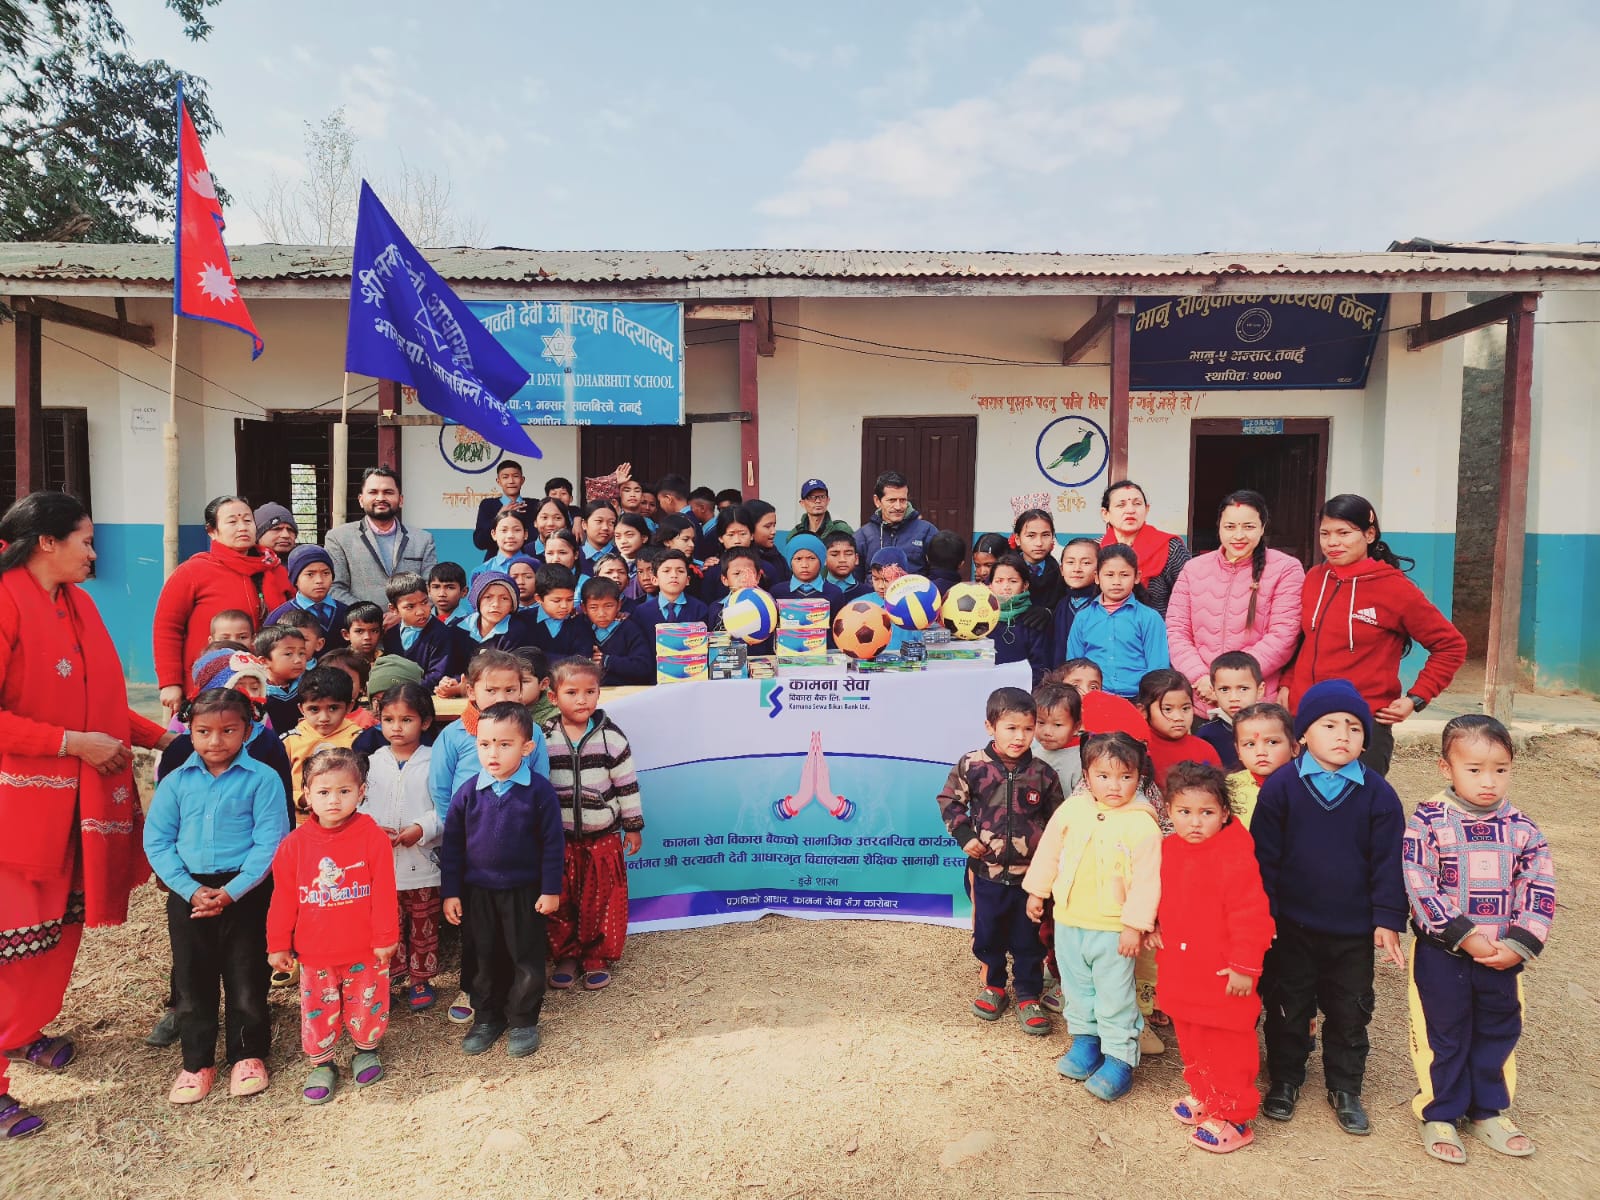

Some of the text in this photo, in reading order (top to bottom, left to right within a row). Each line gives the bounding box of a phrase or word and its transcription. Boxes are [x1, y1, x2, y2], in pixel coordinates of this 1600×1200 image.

[519, 301, 543, 326] देवी
[1135, 301, 1173, 332] भानु
[1338, 293, 1377, 330] केन्द्र
[538, 373, 561, 386] DEVI
[633, 375, 674, 389] SCHOOL
[1252, 371, 1282, 381] २०७०
[789, 676, 871, 692] कामना सेवा
[662, 837, 699, 848] कामना
[704, 834, 724, 846] सेवा
[728, 832, 763, 845] विकास
[802, 834, 852, 847] सामाजिक
[918, 835, 961, 847] कार्यक्र
[664, 855, 678, 867] श्री
[681, 852, 725, 866] सत्यवती
[729, 851, 747, 864] देवी
[805, 853, 860, 866] विद्यालयमा
[299, 881, 371, 907] Captain
[793, 896, 823, 905] कामना
[825, 896, 842, 906] सेवा
[864, 897, 899, 908] कारोबार
